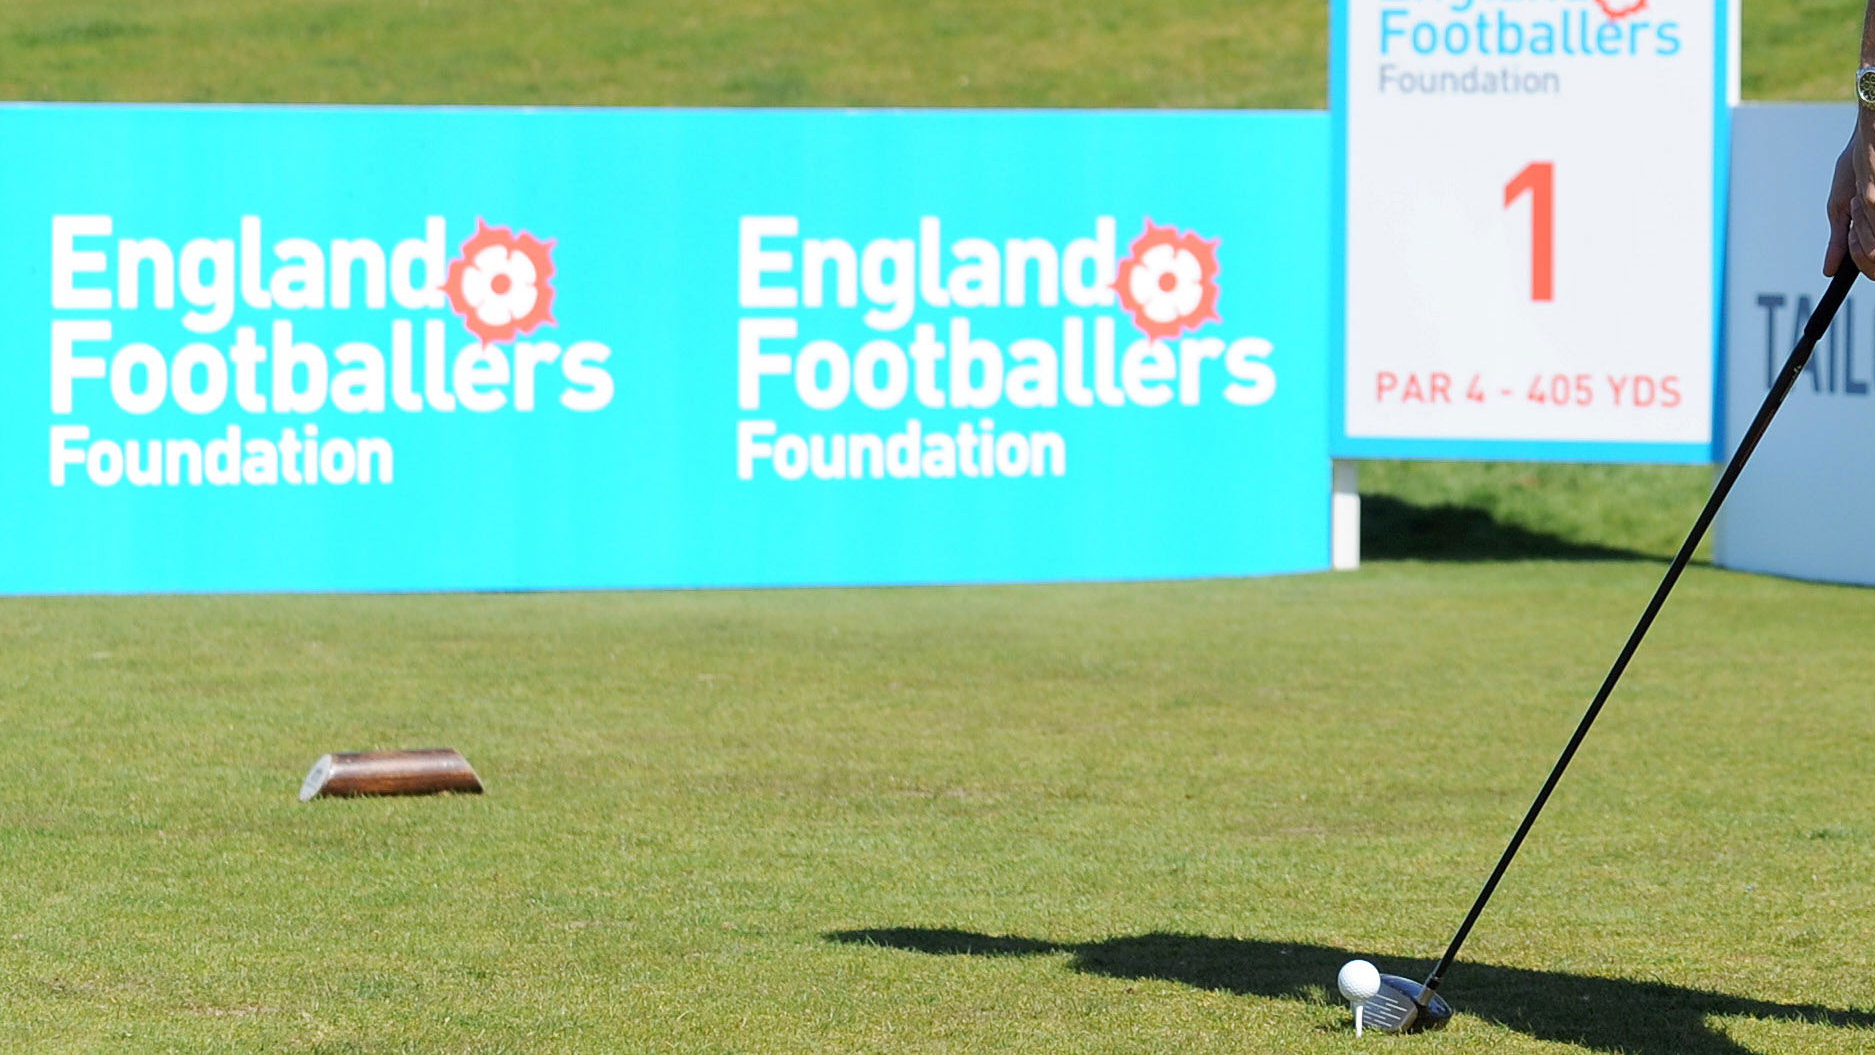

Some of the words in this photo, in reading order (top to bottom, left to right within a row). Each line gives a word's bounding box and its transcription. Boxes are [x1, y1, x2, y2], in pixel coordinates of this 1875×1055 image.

[1379, 9, 1682, 57] Footballers
[1378, 63, 1560, 95] Foundation
[1503, 161, 1555, 303] 1
[50, 214, 447, 334] England
[738, 214, 1117, 332] England
[50, 318, 616, 415] Footballers
[737, 316, 1278, 411] Footballers
[1375, 370, 1452, 404] PAR
[1465, 373, 1487, 404] 4
[1526, 373, 1594, 407] 405
[1606, 374, 1682, 409] YDS
[49, 422, 394, 487] Foundation
[736, 419, 1067, 481] Foundation
